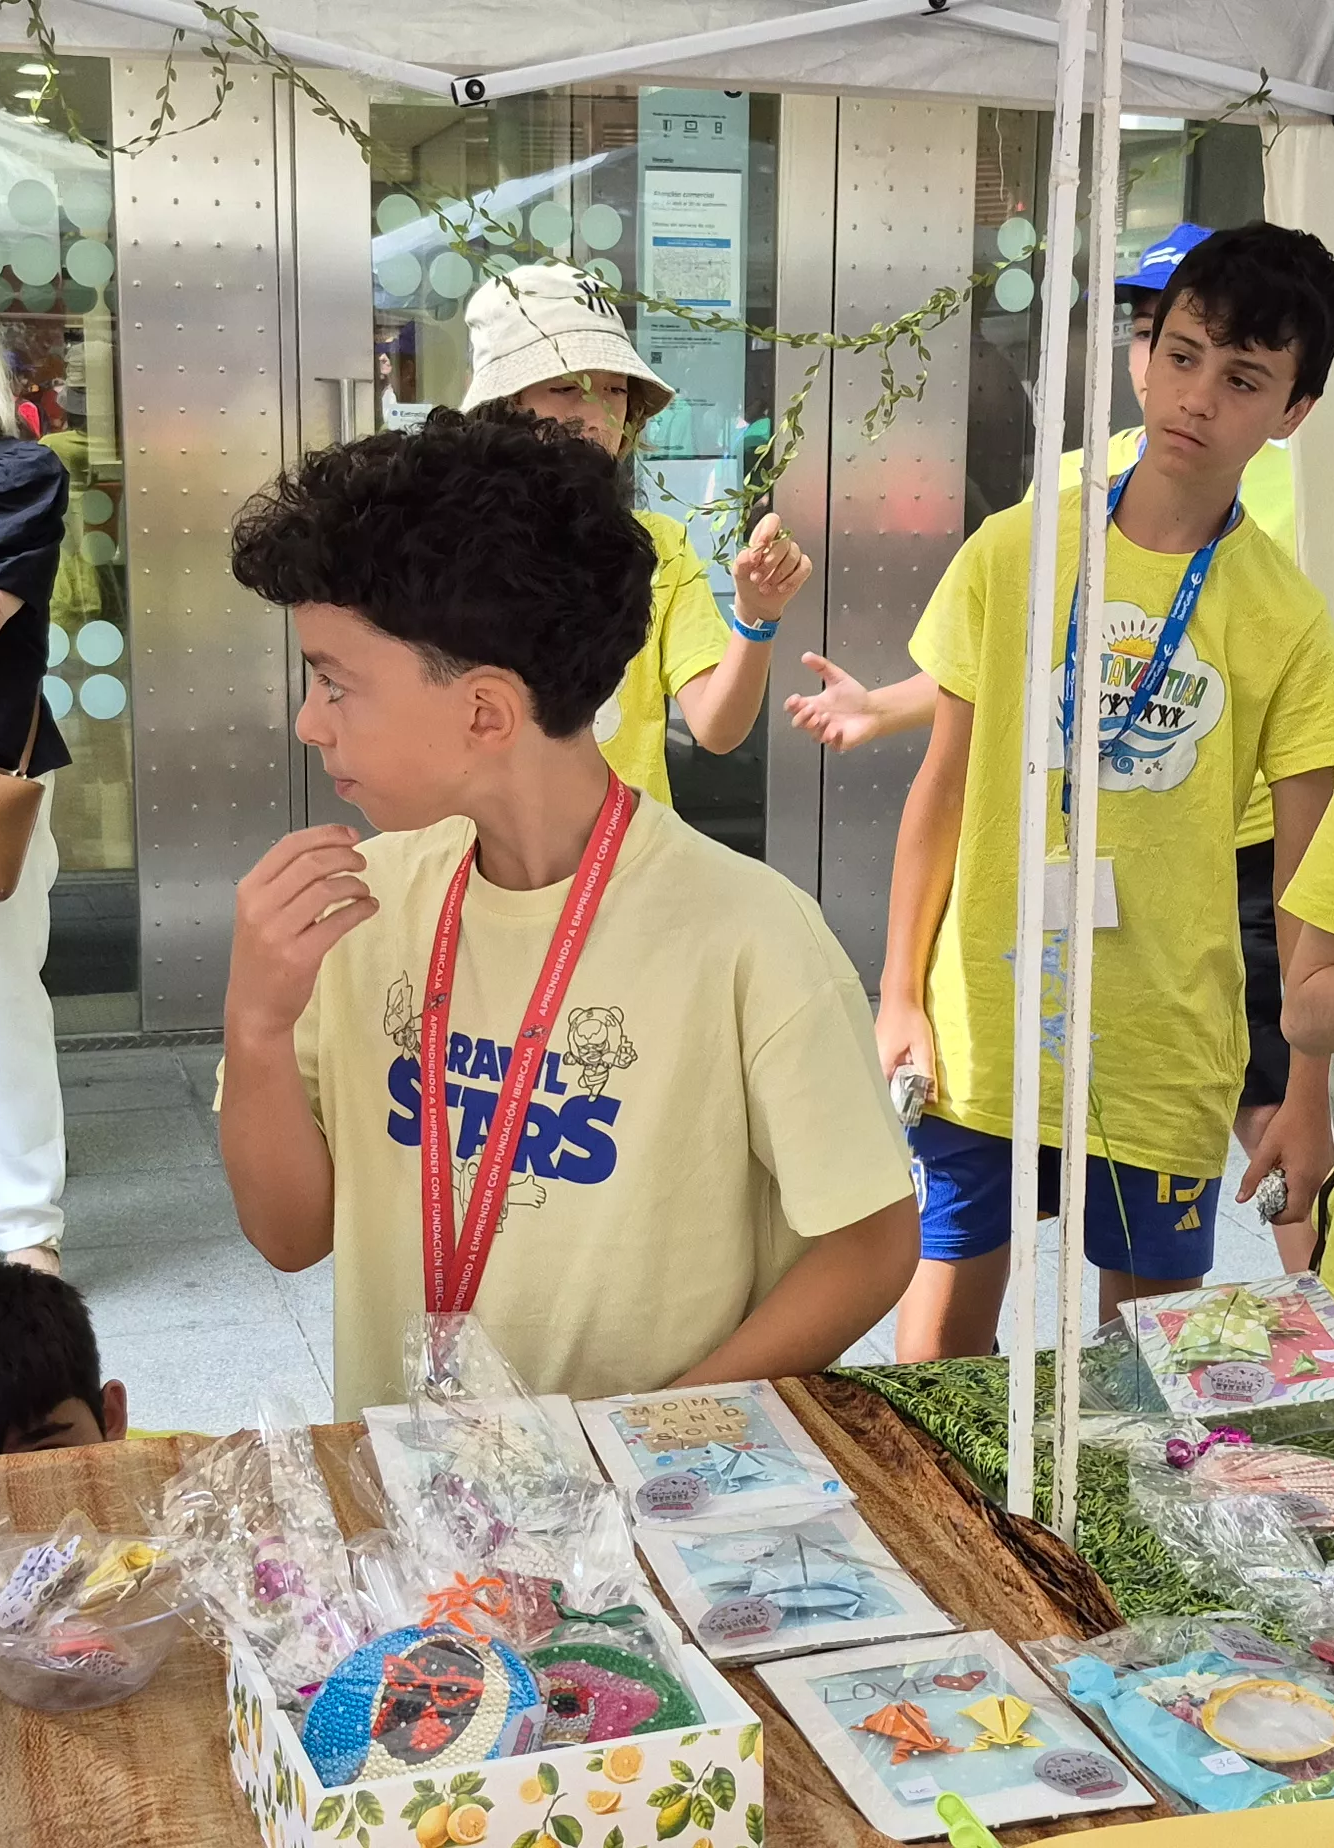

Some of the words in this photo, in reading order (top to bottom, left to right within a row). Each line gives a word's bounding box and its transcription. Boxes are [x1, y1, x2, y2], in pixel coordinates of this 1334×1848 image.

[596, 836, 611, 861] CON
[442, 873, 462, 935] FUNDACIÓN
[570, 862, 602, 926] EMPRENDER
[567, 928, 577, 938] A
[434, 937, 448, 990] IBERCAJA
[538, 937, 572, 1017] APRENDIENDO
[427, 1014, 438, 1093] APRENDIENDO
[512, 1047, 535, 1100] IBERCAJA
[429, 1097, 436, 1105] A
[429, 1107, 440, 1175] EMPRENDER
[493, 1100, 517, 1164] FUNDACIÓN
[431, 1177, 440, 1201] CON
[487, 1163, 501, 1189] CON
[431, 1202, 443, 1267] FUNDACIÓN
[470, 1189, 495, 1257] EMPRENDER
[469, 1251, 477, 1261] A
[630, 1397, 709, 1416] MOM
[662, 1408, 742, 1426] AND
[657, 1423, 732, 1441] SON
[823, 1677, 938, 1705] LOVE
